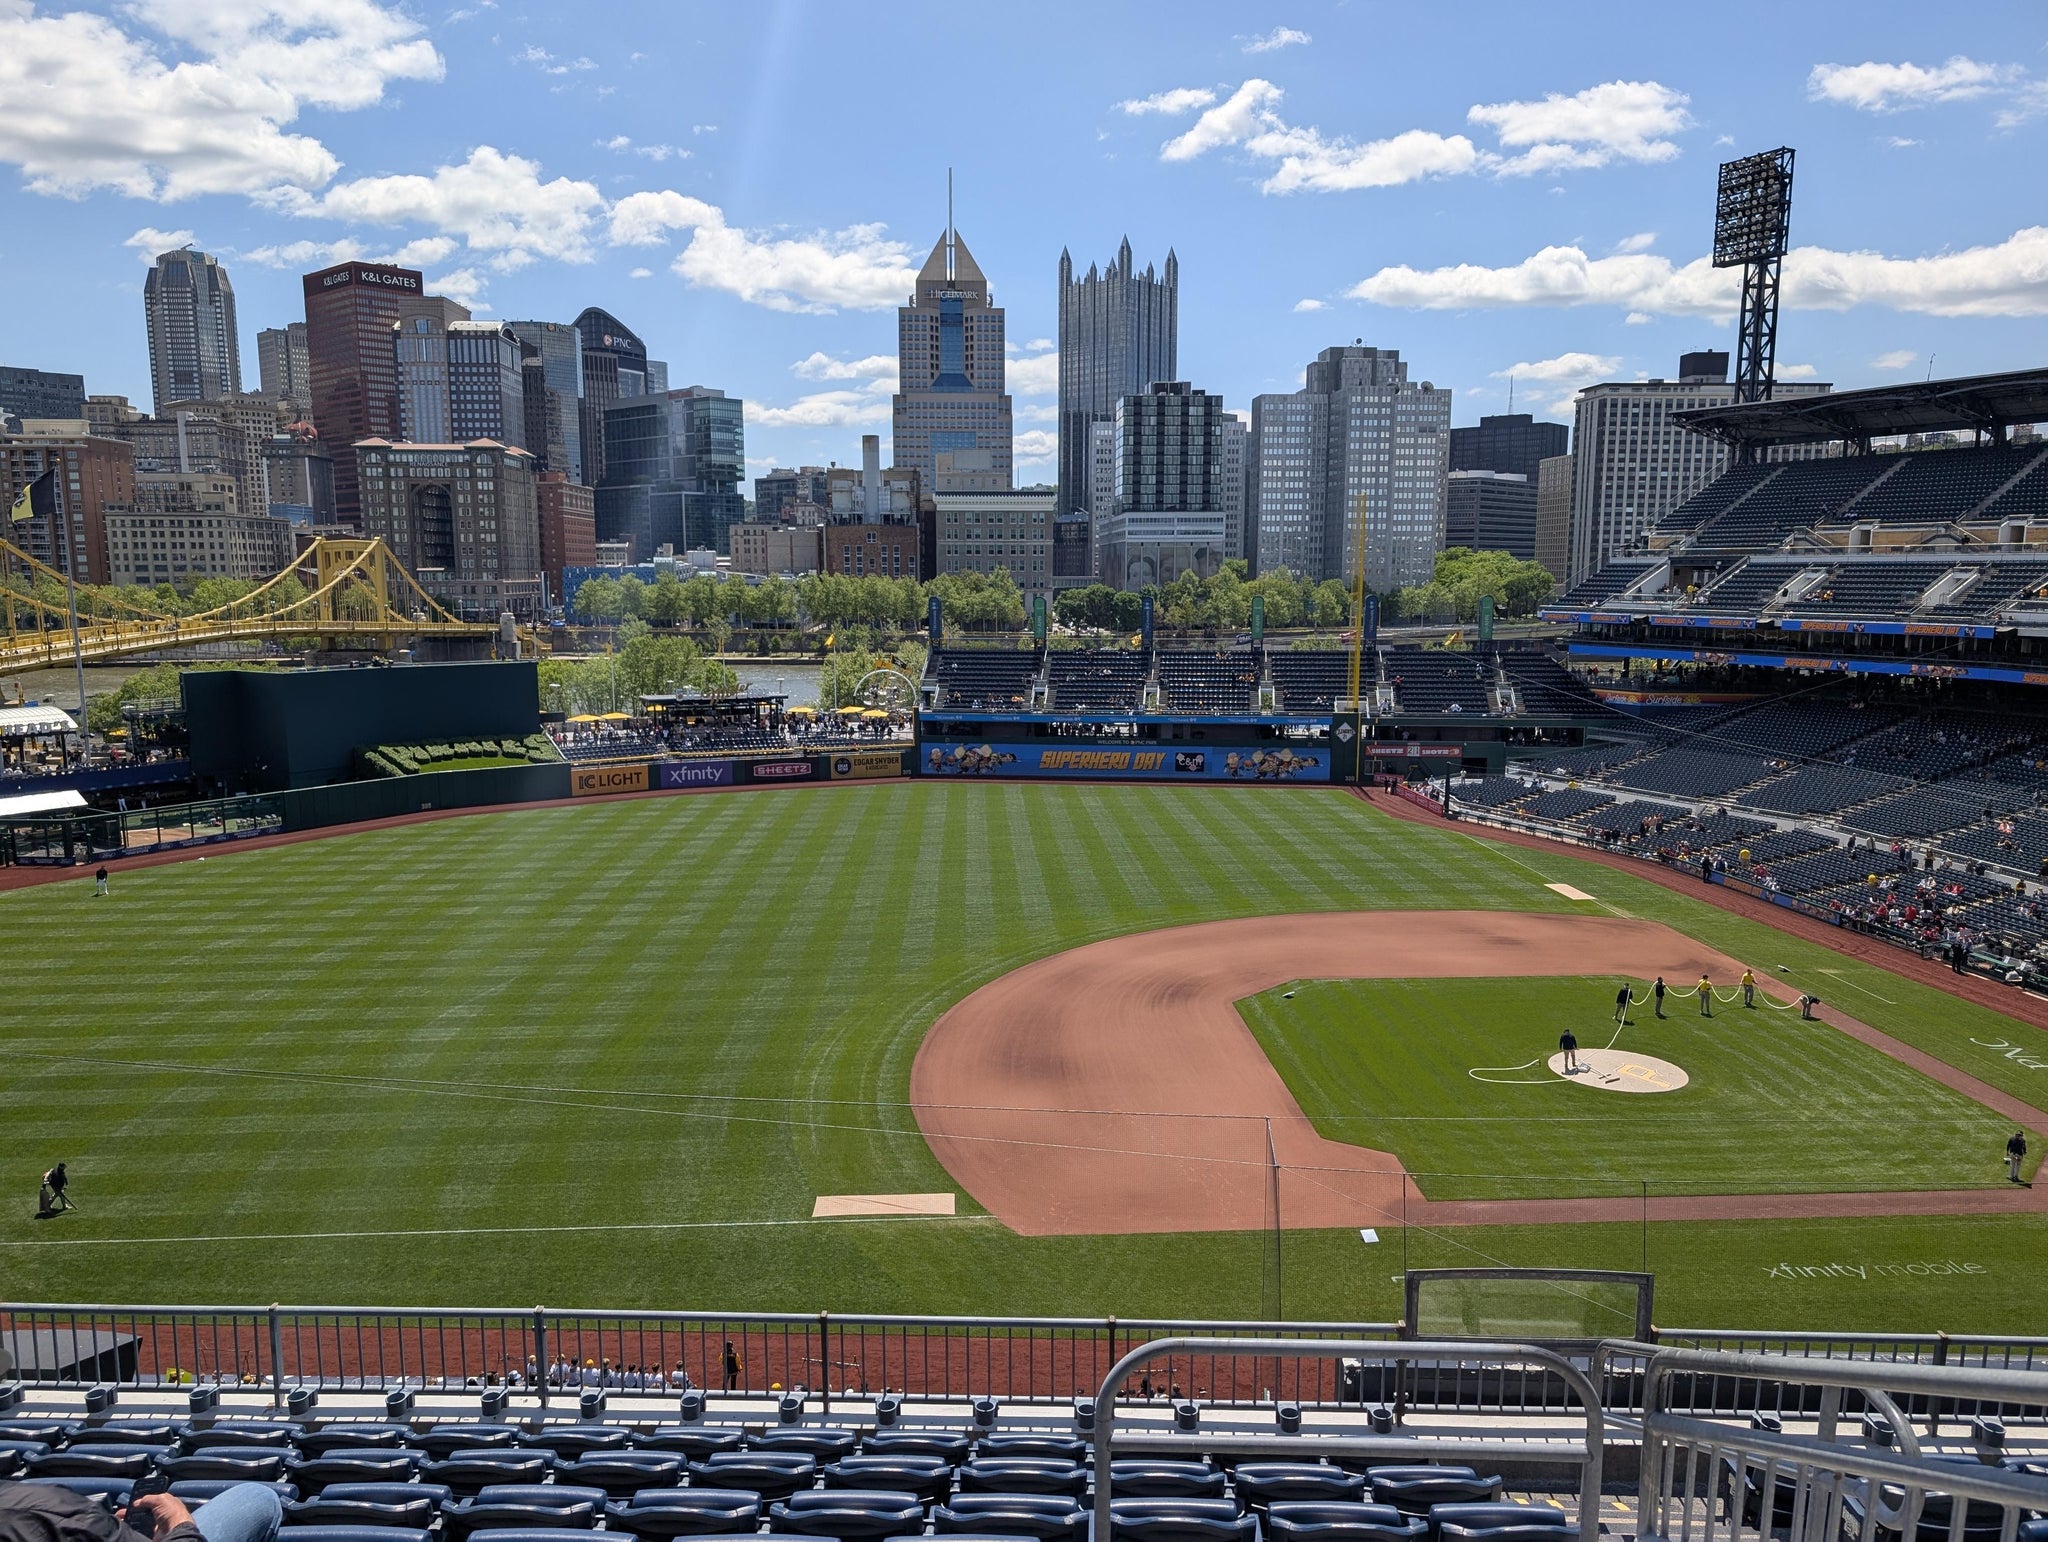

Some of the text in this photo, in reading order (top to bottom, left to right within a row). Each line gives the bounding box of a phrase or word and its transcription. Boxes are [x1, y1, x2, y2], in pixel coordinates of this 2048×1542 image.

[324, 271, 349, 286] K&L GATES
[361, 271, 416, 288] K&L GATES
[613, 336, 632, 349] PNC
[1645, 694, 1683, 704] Surfside
[854, 757, 899, 766] EDGAR SNYDER
[1039, 751, 1167, 770] SUPERHERO DAY
[670, 766, 723, 783] xfinity
[758, 765, 808, 774] SHEETZ
[578, 772, 642, 789] IC LIGHT
[1762, 1260, 1987, 1280] xfinity mobile
